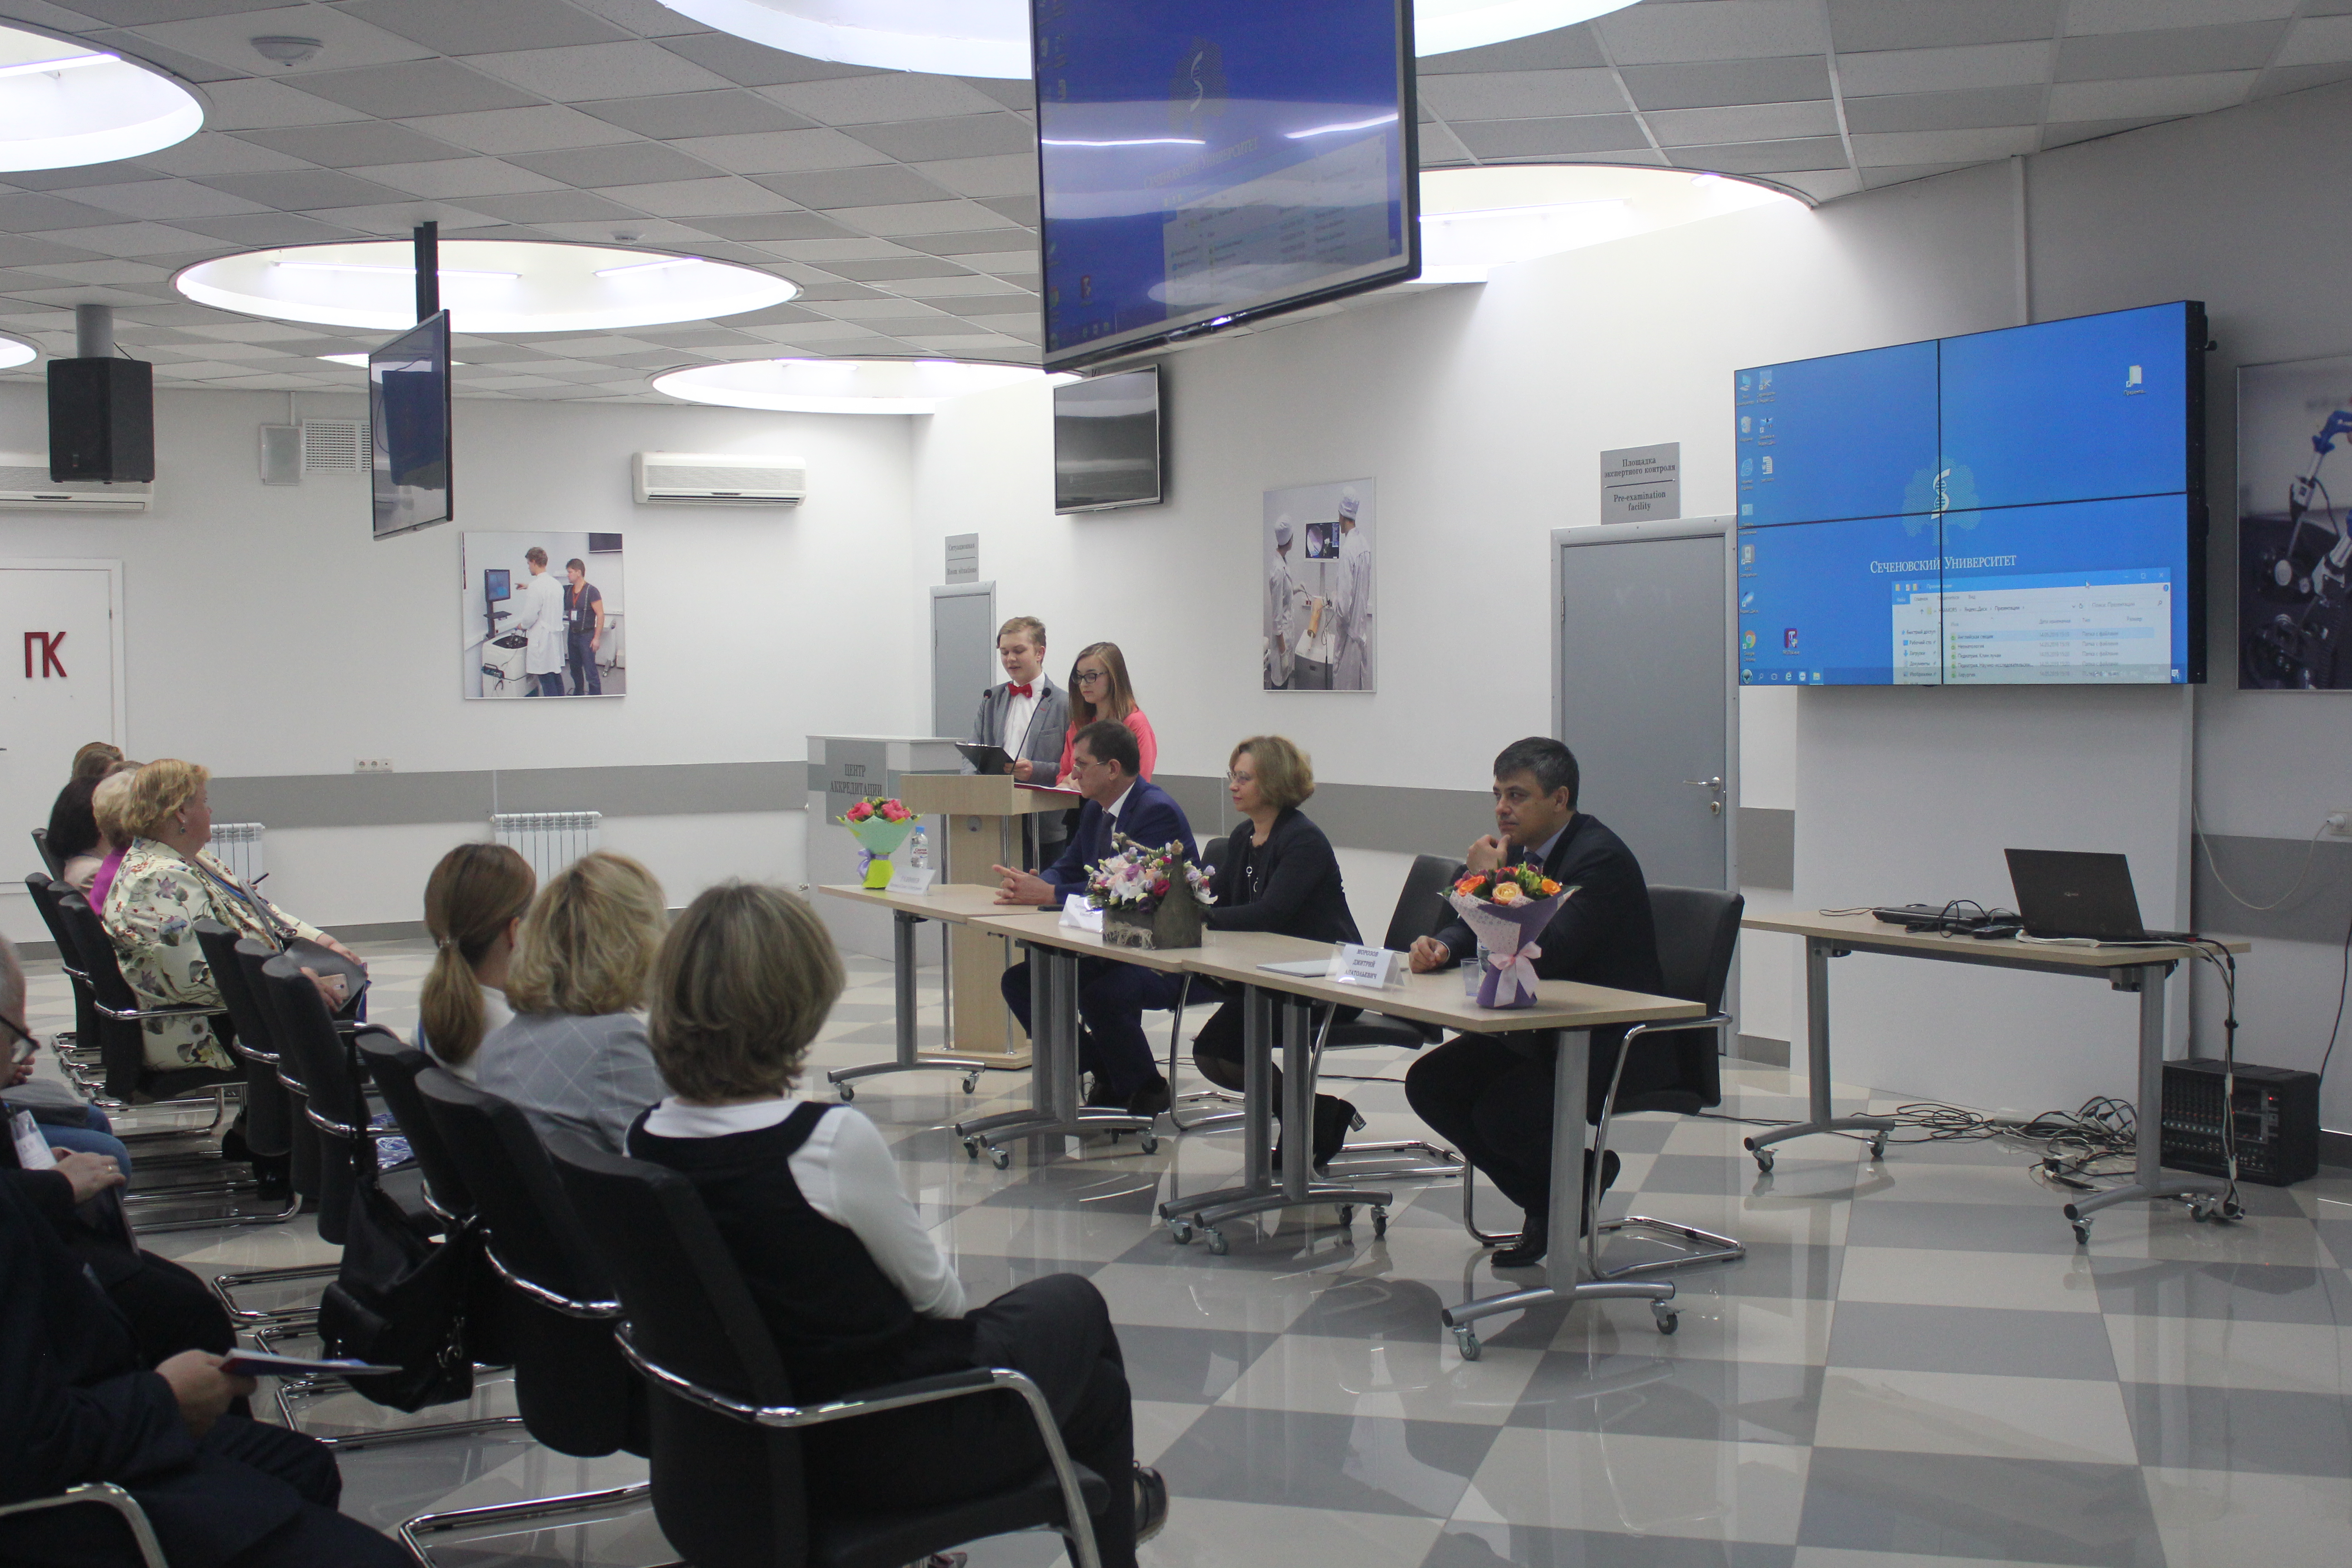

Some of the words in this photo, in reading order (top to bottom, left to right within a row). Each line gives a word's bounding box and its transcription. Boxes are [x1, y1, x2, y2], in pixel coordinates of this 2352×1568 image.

[1622, 458, 1656, 467] Площадка
[1604, 468, 1642, 478] экспертного
[1645, 465, 1675, 474] контроля
[1614, 490, 1666, 502] Pre-examination
[1628, 502, 1651, 511] facility
[948, 543, 975, 552] Ситуационная
[24, 632, 68, 678] ПК
[844, 764, 866, 776] ЦЕНТР
[830, 780, 882, 797] АККРЕДИТАЦИИ
[1357, 949, 1379, 957] МОРОЗОВ
[1352, 959, 1376, 968] ДМИТРИЙ
